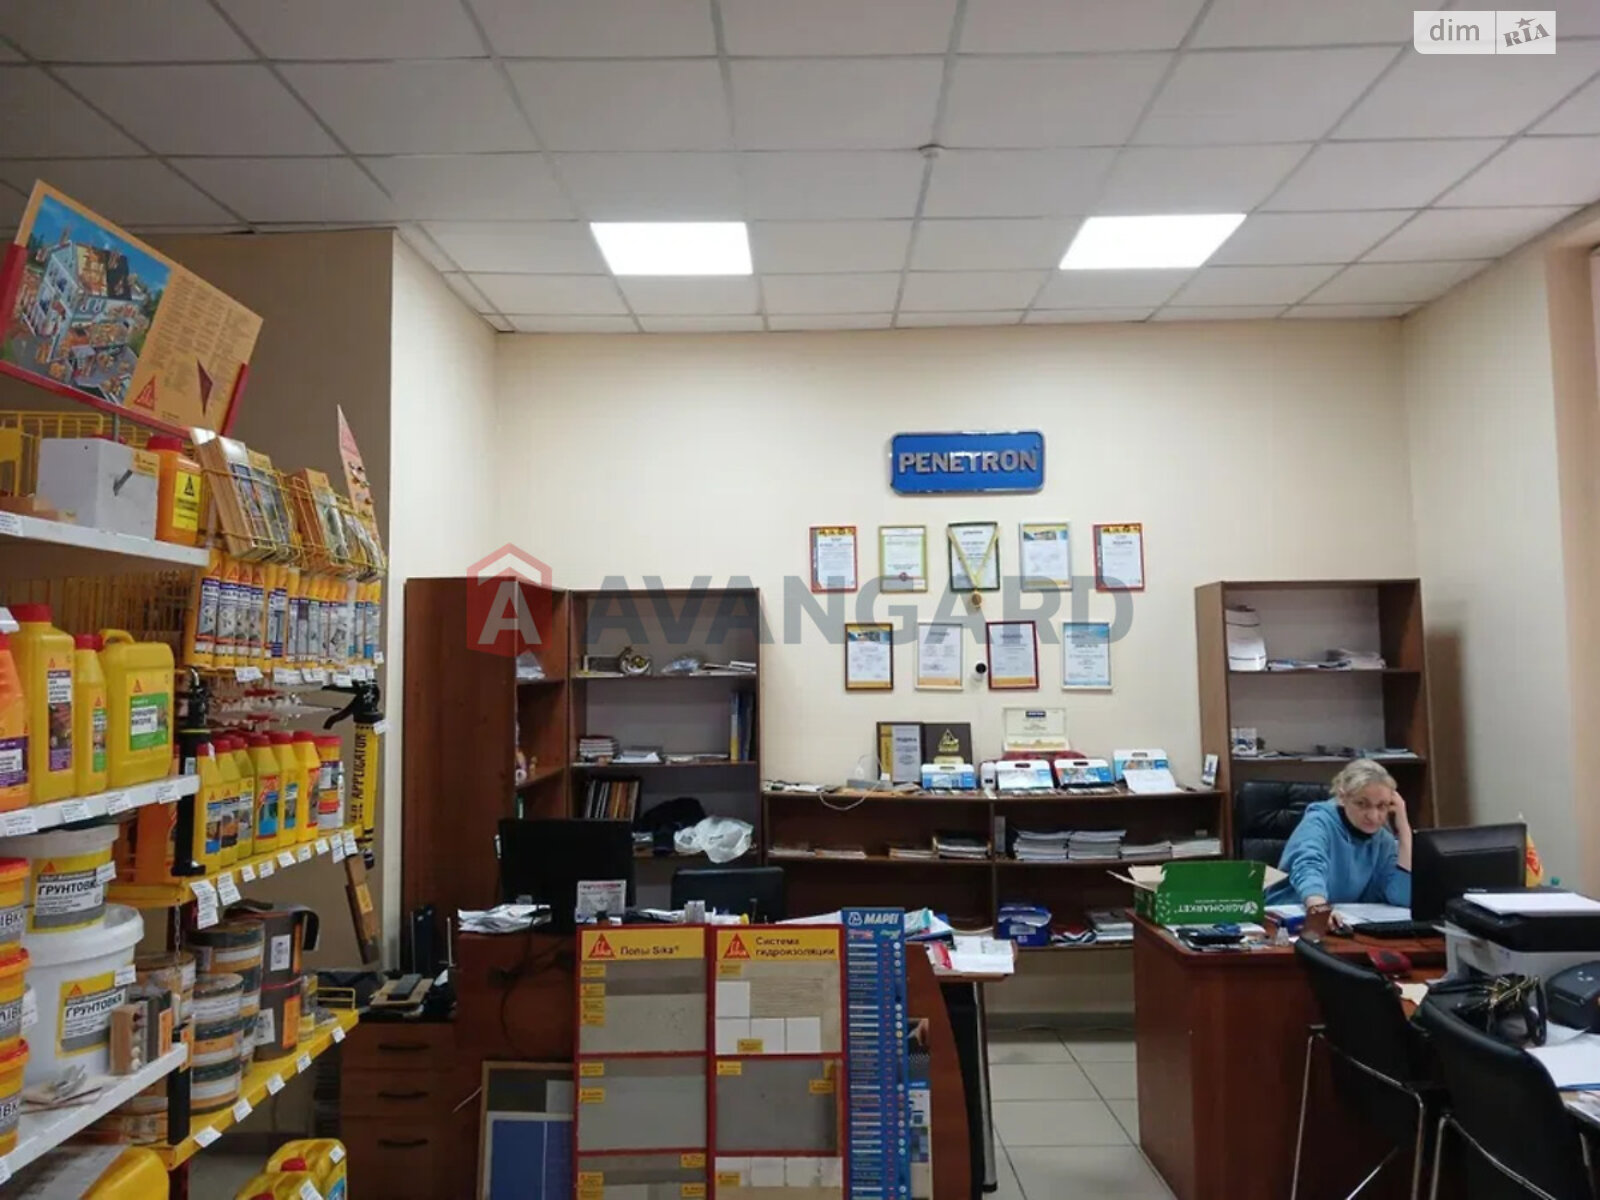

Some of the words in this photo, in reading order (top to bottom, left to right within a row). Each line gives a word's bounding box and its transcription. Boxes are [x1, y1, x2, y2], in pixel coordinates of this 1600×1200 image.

[898, 450, 1037, 473] PENETRON
[38, 879, 102, 896] ГРУНТОВК
[864, 913, 899, 925] MAPEI
[755, 937, 800, 946] Система
